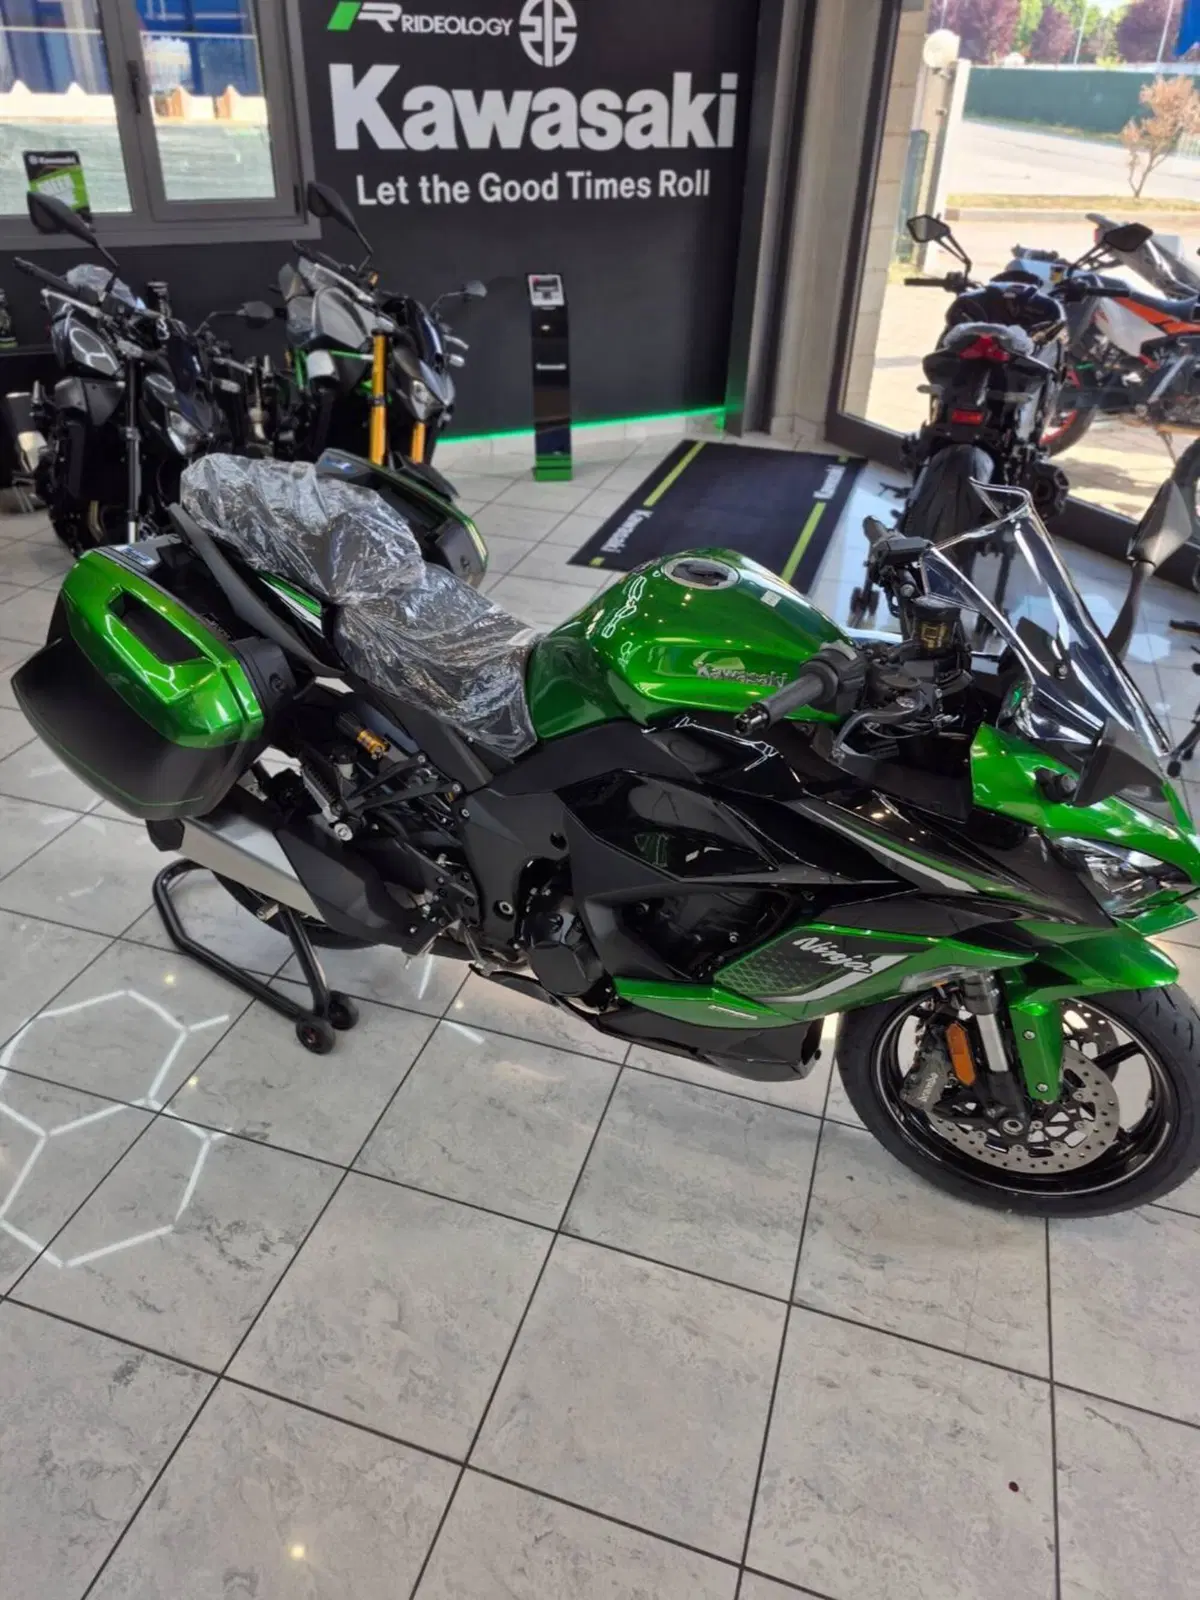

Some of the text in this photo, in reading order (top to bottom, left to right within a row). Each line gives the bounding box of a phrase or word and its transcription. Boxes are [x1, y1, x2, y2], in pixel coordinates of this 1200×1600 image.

[402, 15, 513, 36] RIDEOLOGY
[328, 63, 738, 151] Kawasaki
[356, 169, 710, 205] Let the Good Times Roll
[792, 937, 873, 974] Ninja
